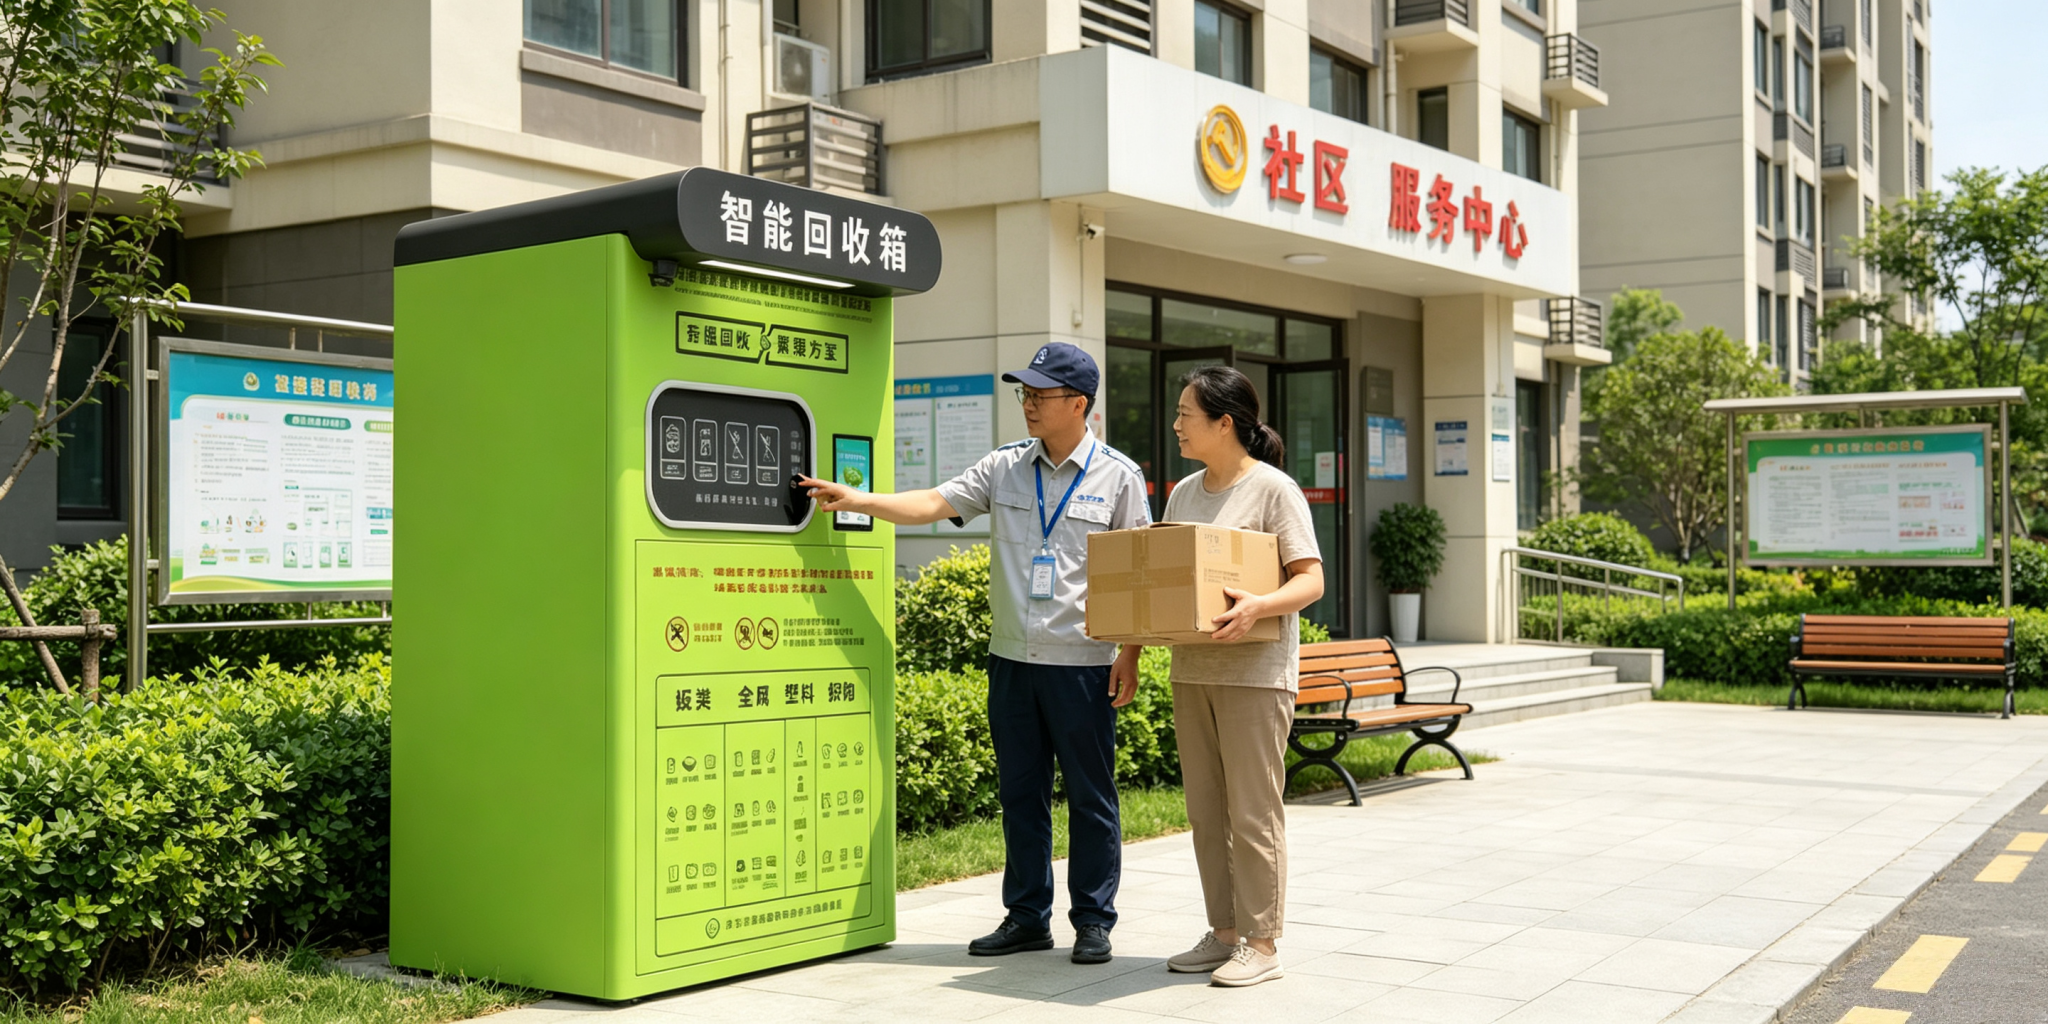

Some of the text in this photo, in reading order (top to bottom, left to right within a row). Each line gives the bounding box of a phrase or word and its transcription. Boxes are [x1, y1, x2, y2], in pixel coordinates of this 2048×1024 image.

[720, 190, 908, 273] 智能回收箱
[1264, 125, 1528, 258] 社区 服务中心
